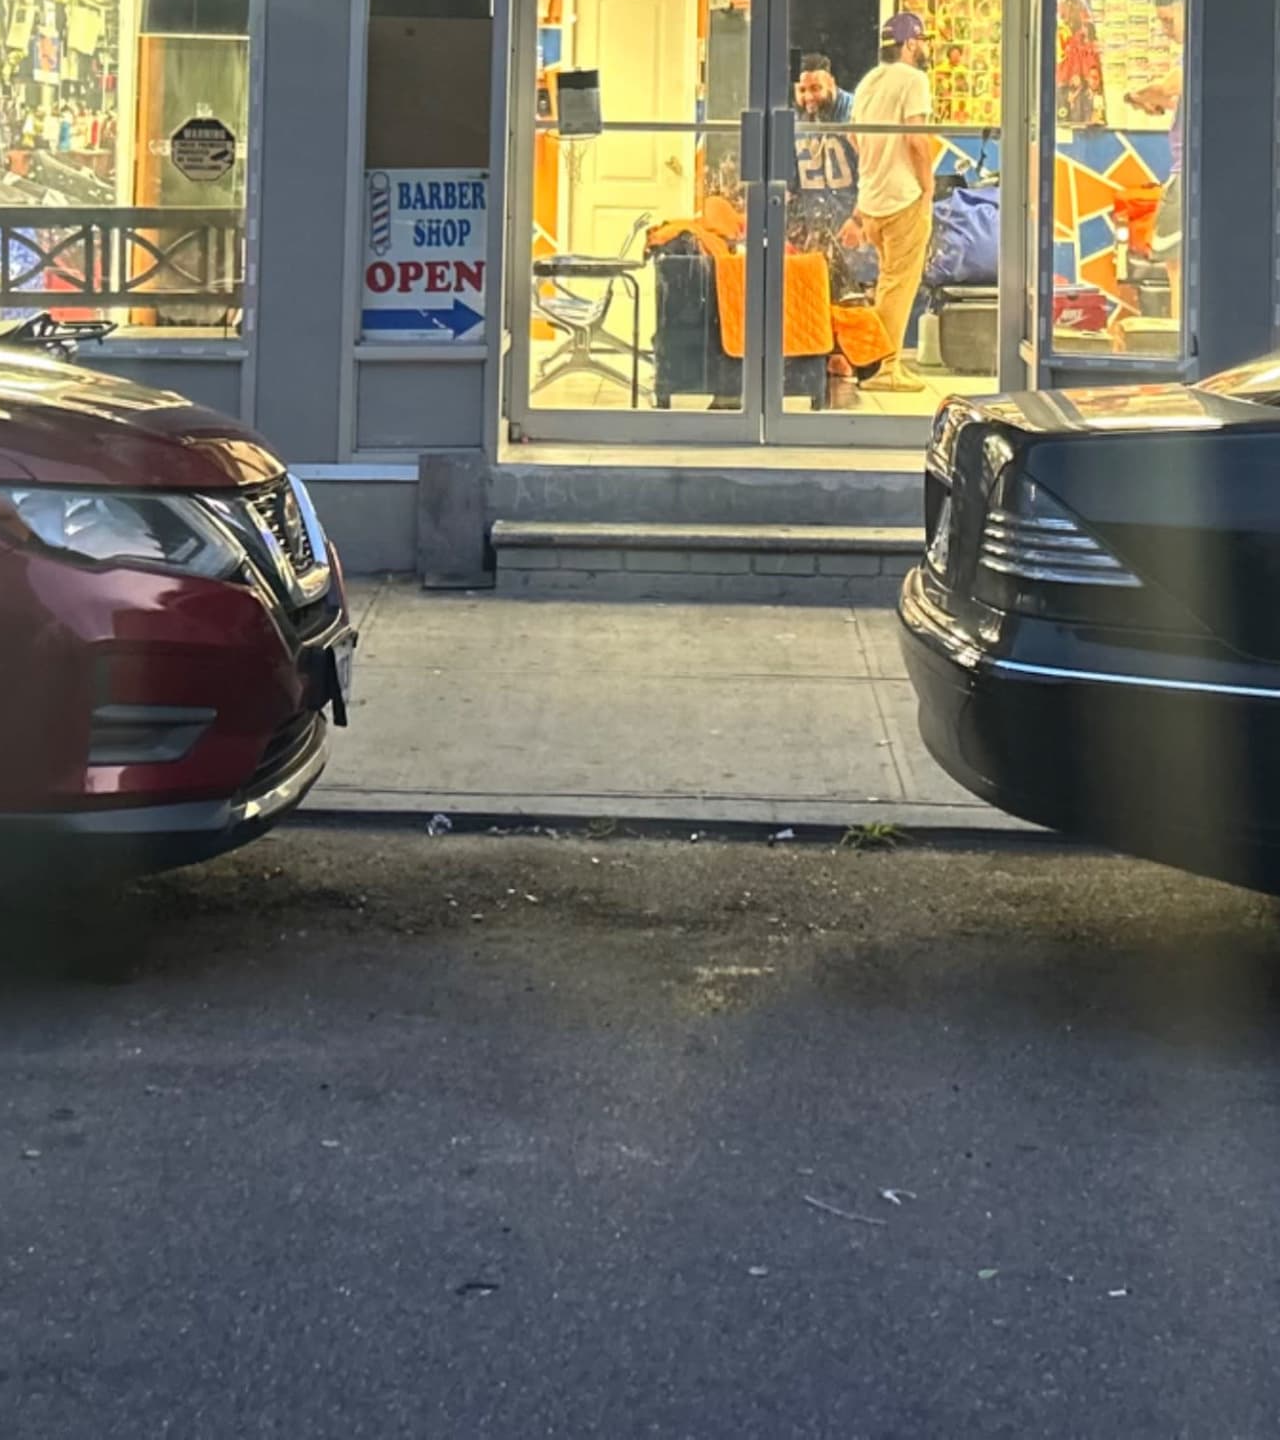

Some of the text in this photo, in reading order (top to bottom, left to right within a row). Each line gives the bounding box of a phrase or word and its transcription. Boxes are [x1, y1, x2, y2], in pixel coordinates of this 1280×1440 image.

[795, 135, 853, 190] 20
[397, 181, 487, 211] BARBER
[412, 219, 472, 248] SHOP
[365, 260, 486, 294] OPEN
